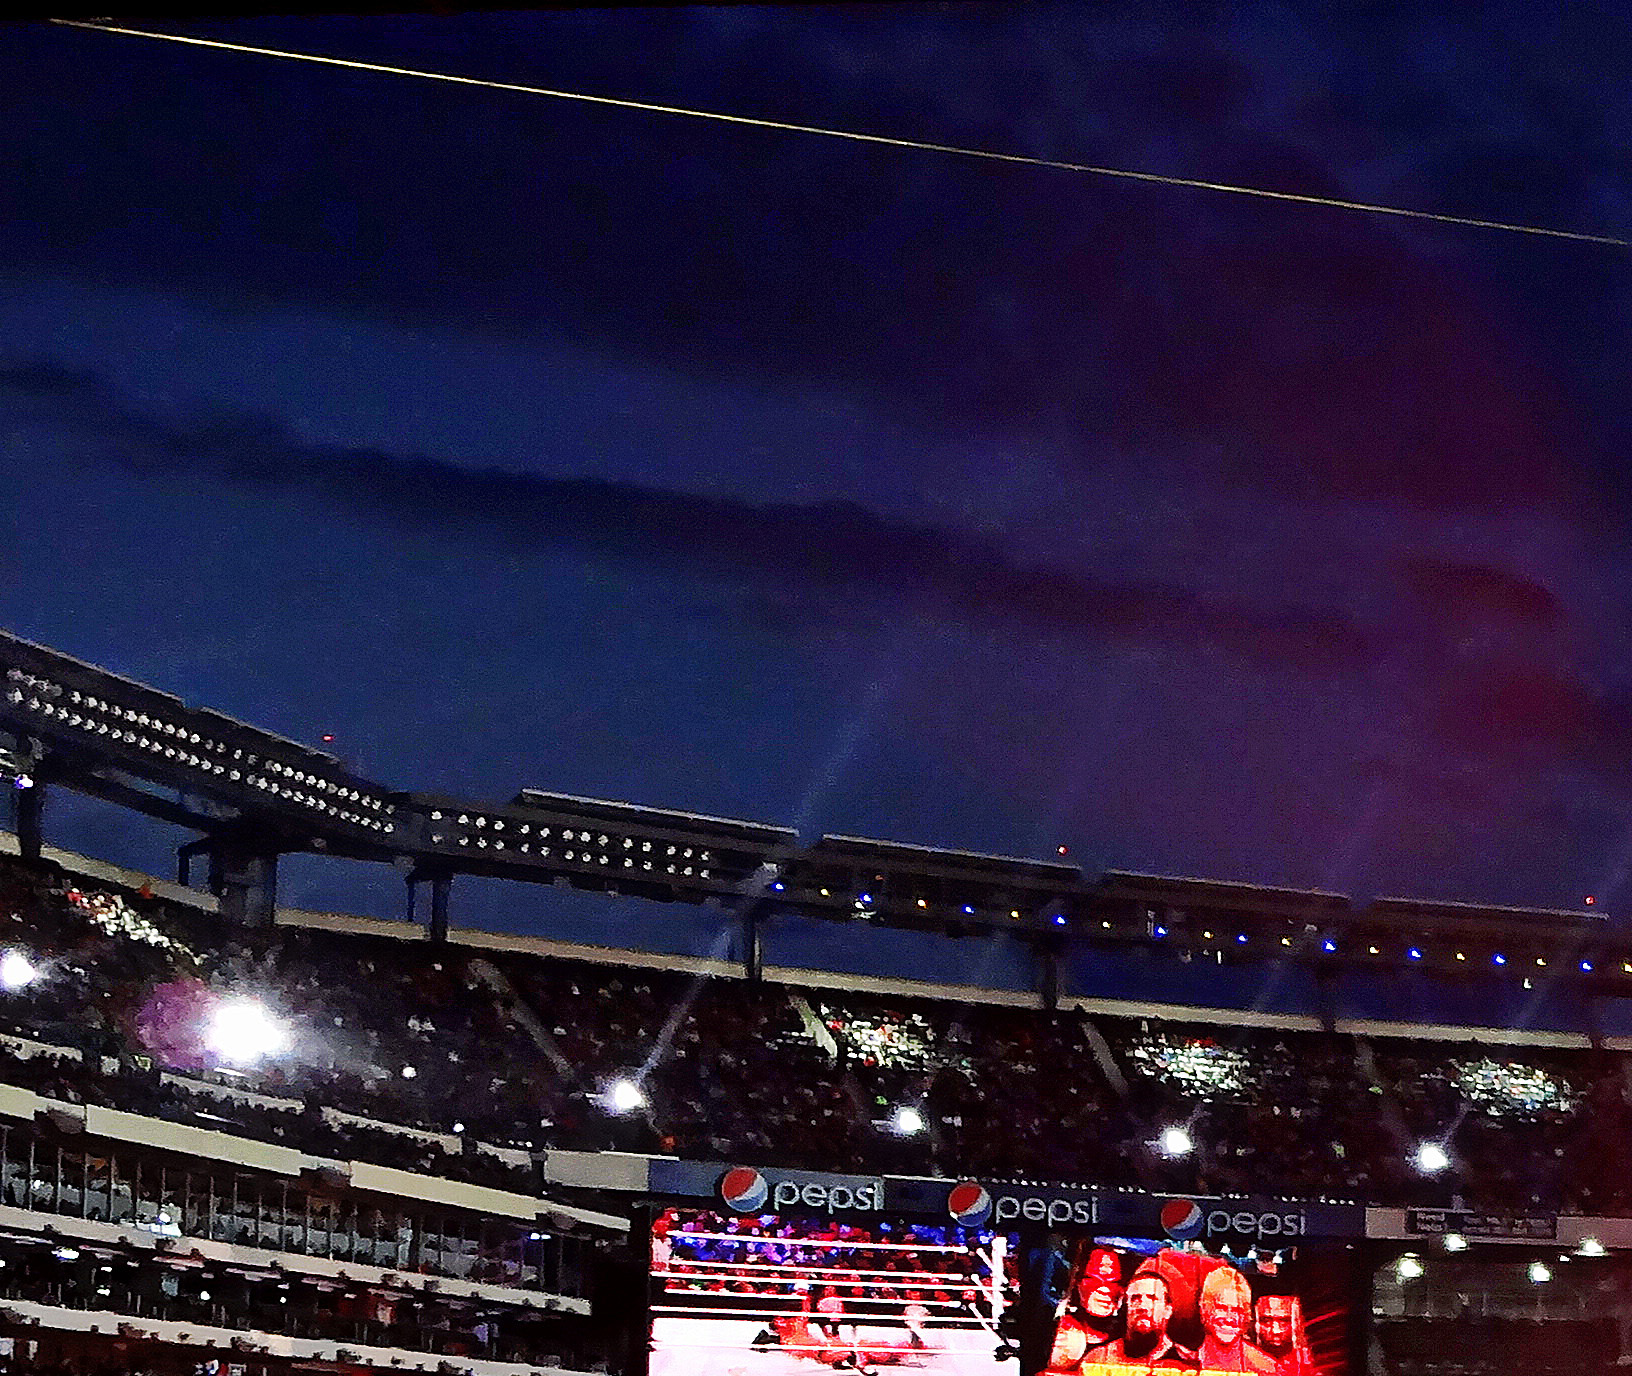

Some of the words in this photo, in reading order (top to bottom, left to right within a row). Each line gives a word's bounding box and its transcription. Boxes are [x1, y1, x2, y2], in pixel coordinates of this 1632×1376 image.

[774, 1180, 883, 1214] pepsi
[996, 1196, 1099, 1228] pepsi
[1206, 1208, 1306, 1239] pepsi
